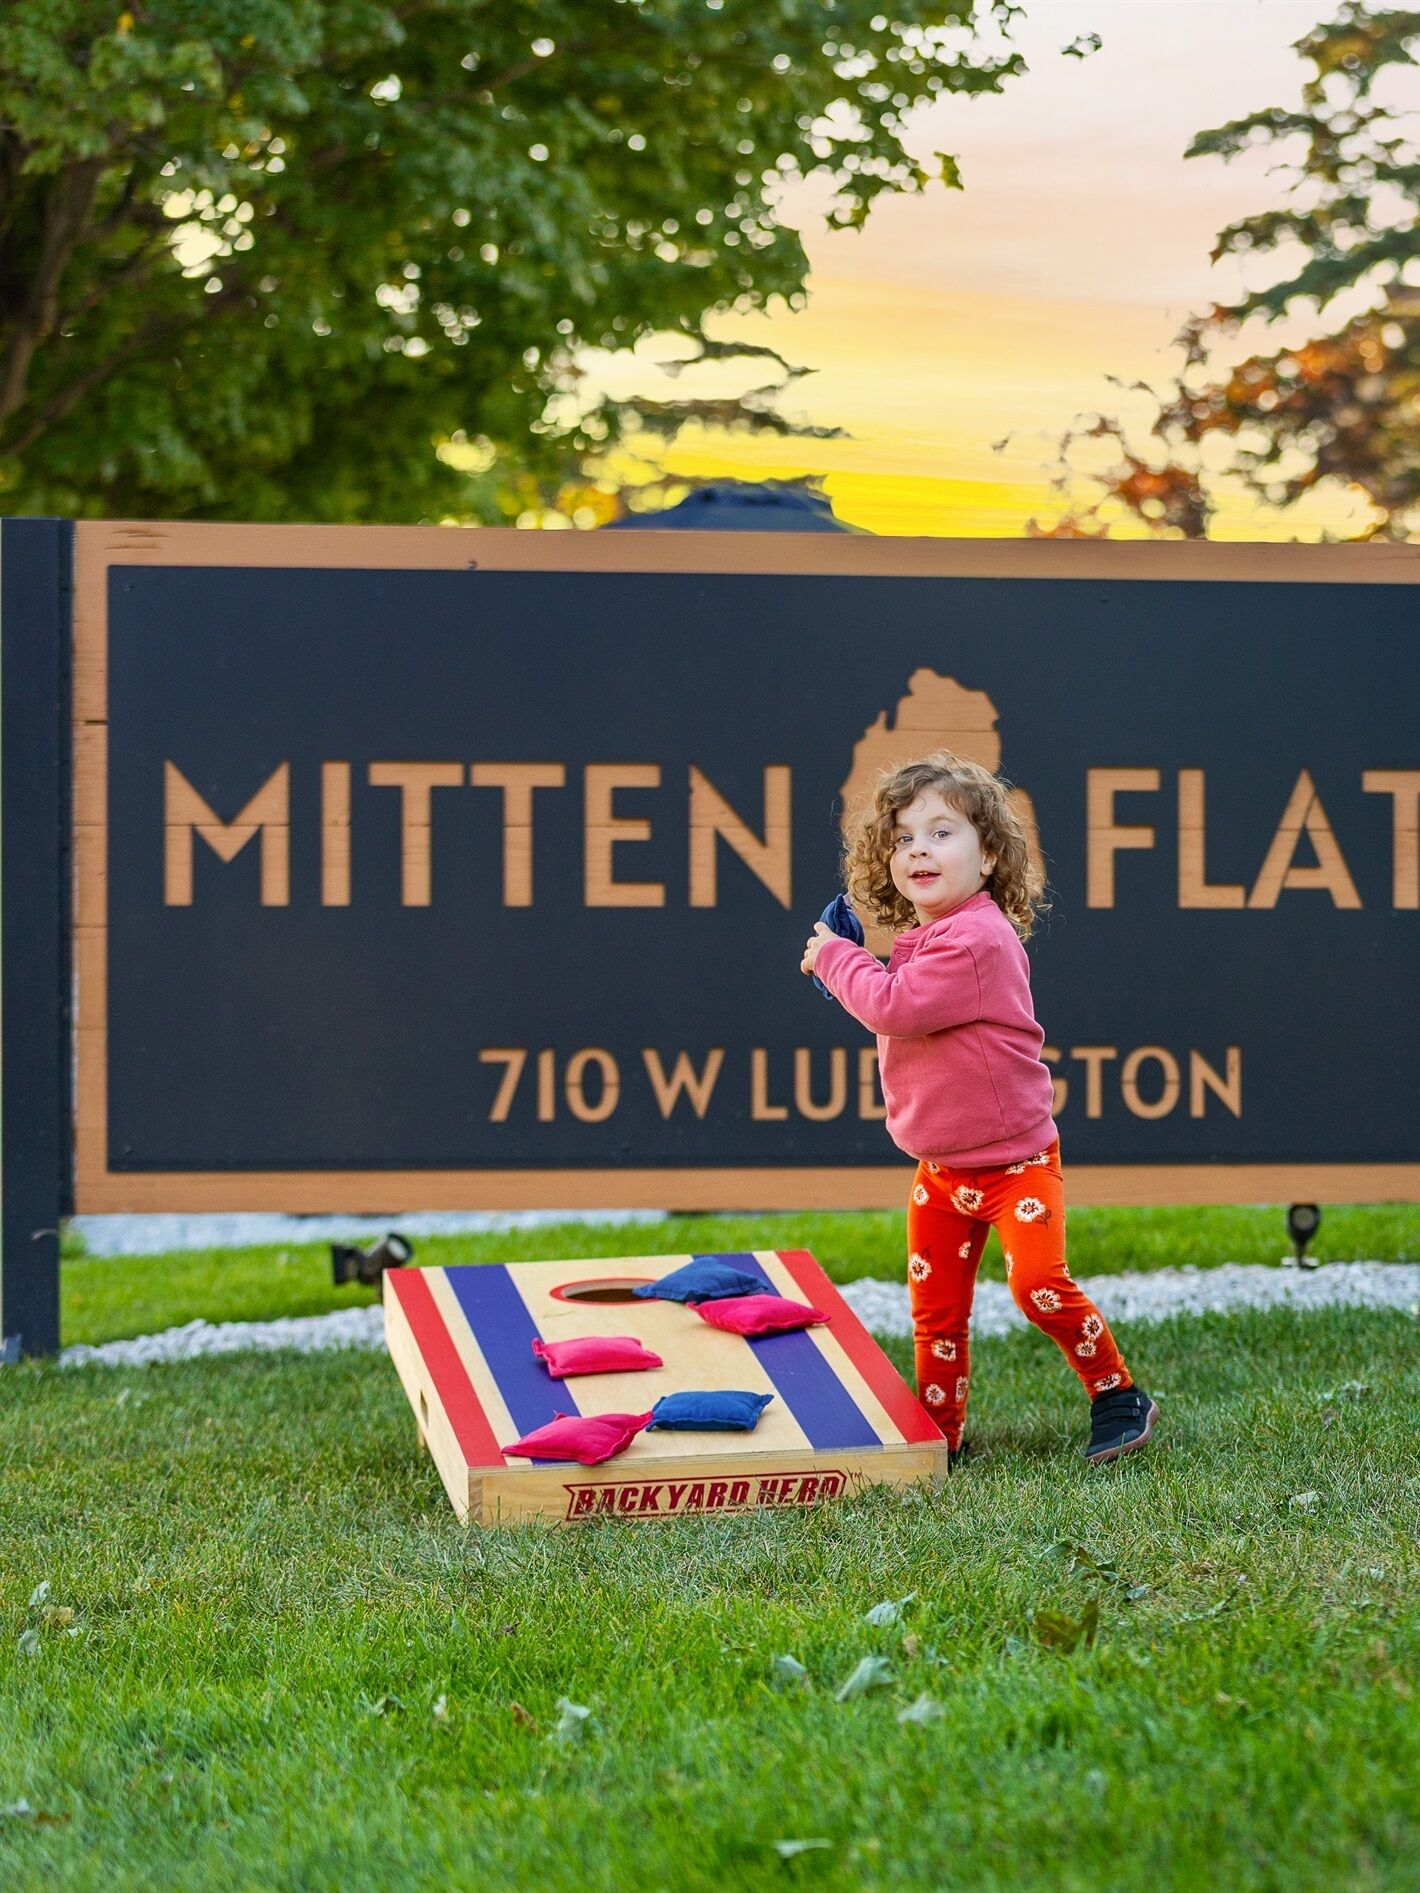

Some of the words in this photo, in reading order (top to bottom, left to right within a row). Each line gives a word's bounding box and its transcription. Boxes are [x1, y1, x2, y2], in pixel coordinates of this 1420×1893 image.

[165, 761, 790, 909] MITTEN
[479, 1048, 619, 1121] 710
[644, 1048, 724, 1119] W
[573, 1480, 750, 1515] BACKYARD
[757, 1476, 840, 1504] HERO
